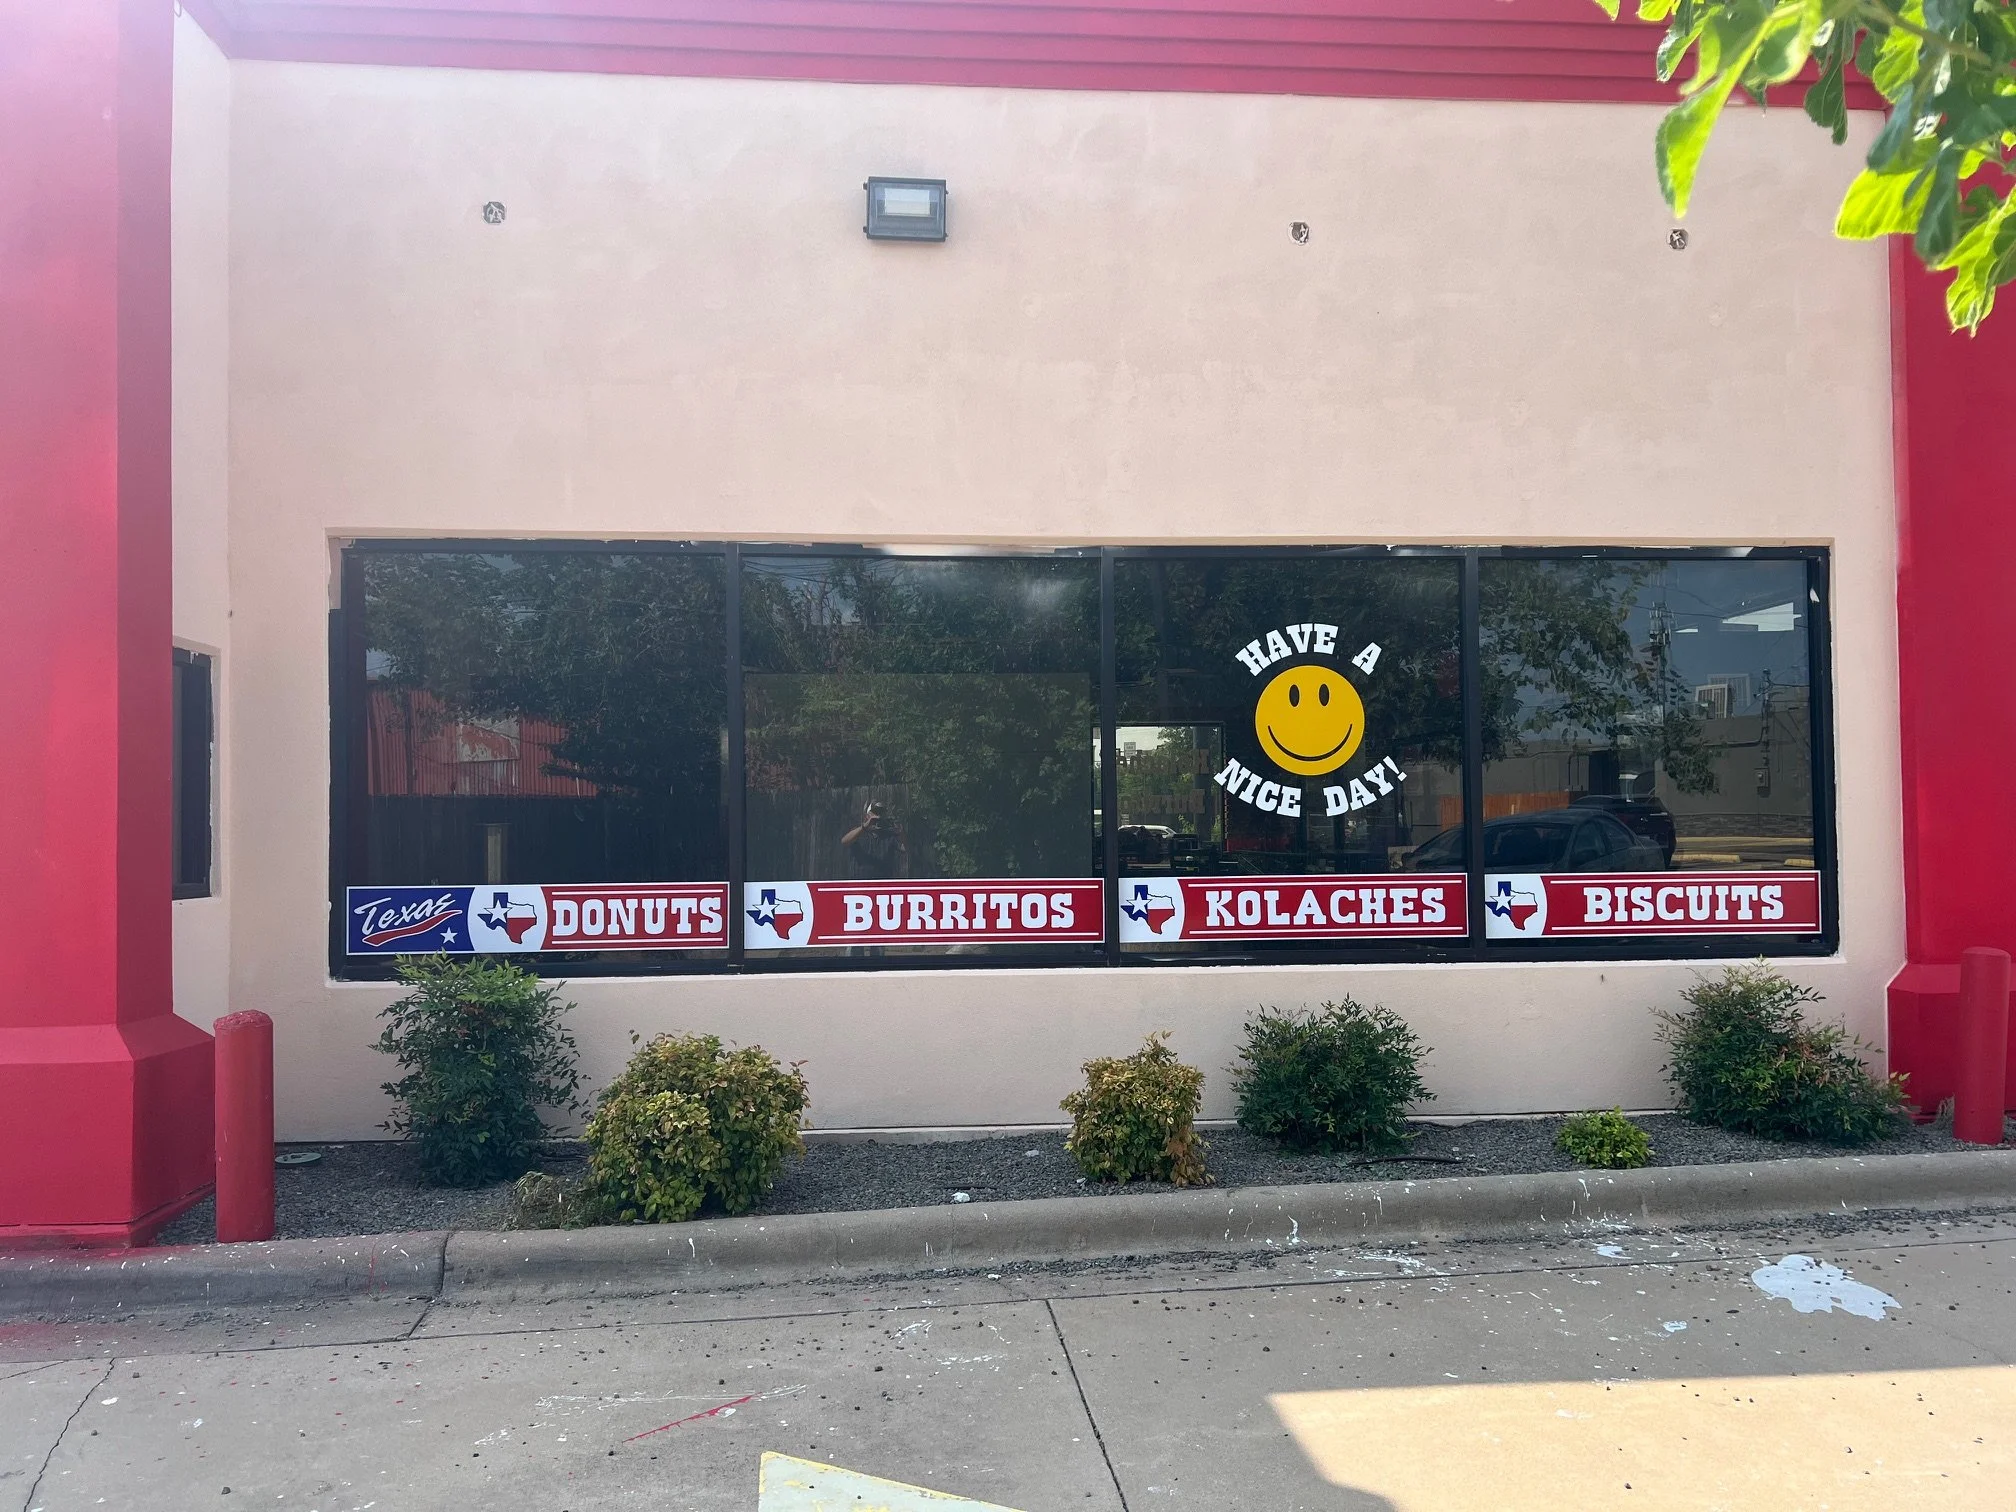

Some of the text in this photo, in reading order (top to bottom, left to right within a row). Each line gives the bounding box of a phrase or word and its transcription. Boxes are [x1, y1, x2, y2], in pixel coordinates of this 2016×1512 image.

[1235, 624, 1381, 676] HAVE A
[1214, 758, 1301, 817] NICE
[1323, 756, 1407, 816] DAY!
[354, 893, 722, 936] Texas DONUTS
[844, 893, 1074, 931] BURRITOS
[1206, 888, 1445, 926] KOLACHES
[1584, 886, 1783, 922] BISCUITS
